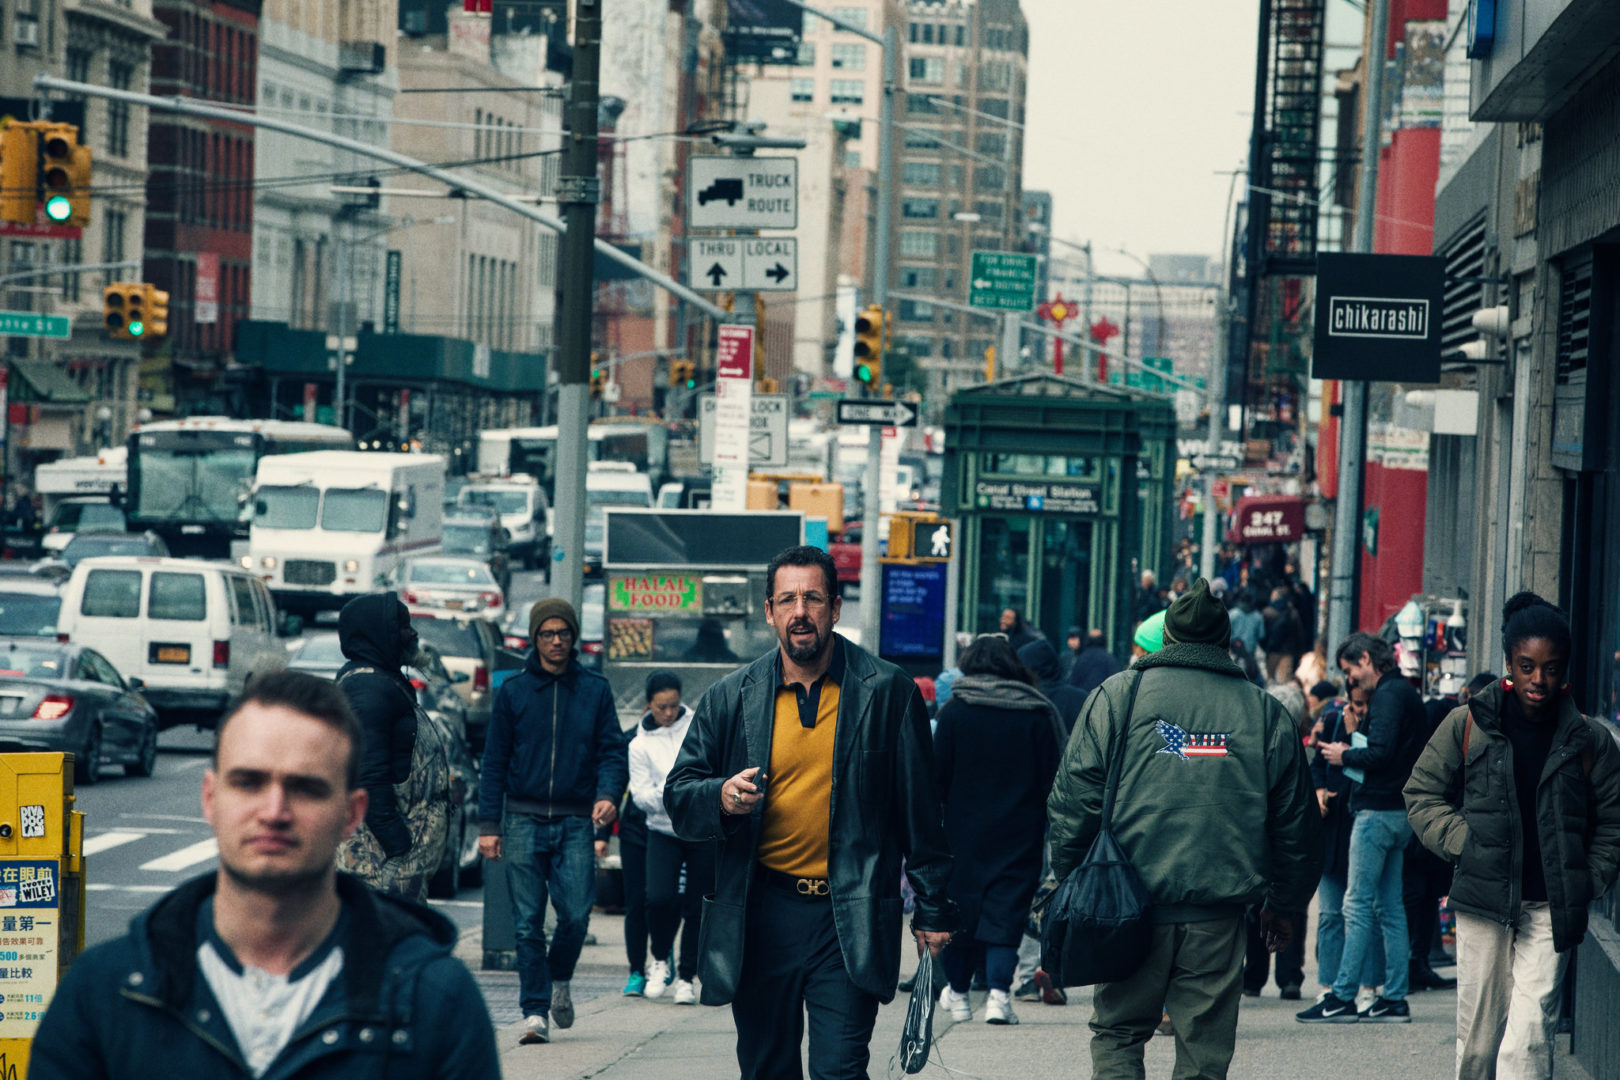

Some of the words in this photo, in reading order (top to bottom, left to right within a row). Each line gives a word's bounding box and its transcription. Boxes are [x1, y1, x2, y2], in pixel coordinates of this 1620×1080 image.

[748, 173, 791, 187] TRUCK
[747, 198, 791, 212] ROUTE
[700, 242, 736, 256] THRU
[747, 242, 790, 256] LOCAL
[0, 318, 29, 330] tte
[36, 319, 53, 331] St
[1335, 304, 1423, 332] chikarashi
[751, 400, 781, 413] LOCK
[977, 482, 1009, 495] Canal
[1012, 484, 1047, 497] Street
[1050, 485, 1092, 499] Station
[1251, 511, 1284, 526] 247
[1243, 526, 1274, 538] CANAL
[624, 577, 689, 591] HALAL
[631, 593, 681, 607] FOOD
[21, 805, 44, 818] DIVA
[21, 816, 44, 827] DOG
[0, 866, 52, 883] 在眼前
[26, 880, 46, 889] VOTE
[23, 885, 52, 900] WILEY
[2, 915, 52, 931] 量第一
[0, 938, 44, 946] 告效果可靠
